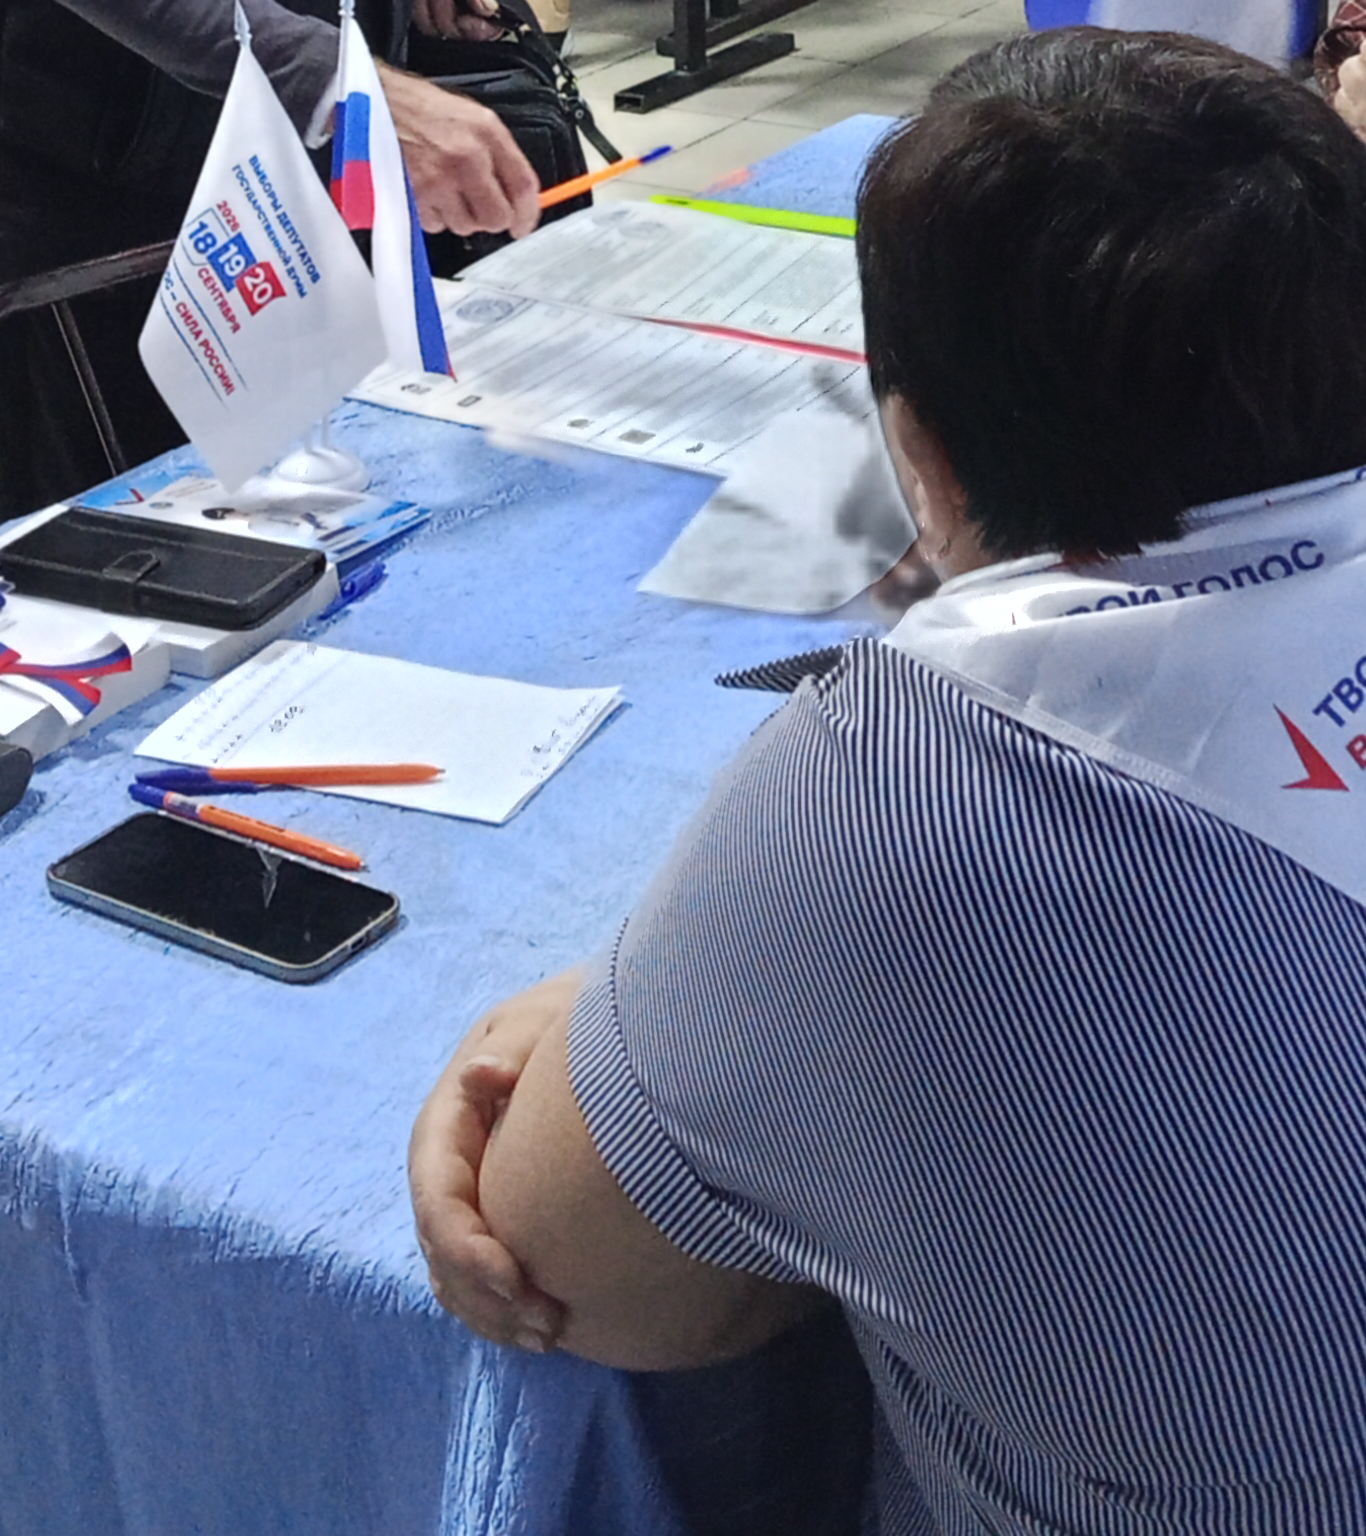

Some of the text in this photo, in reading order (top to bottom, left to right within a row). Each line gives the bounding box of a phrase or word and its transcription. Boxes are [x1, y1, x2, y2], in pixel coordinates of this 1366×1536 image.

[188, 220, 217, 255] 18
[216, 200, 241, 233] 2026
[232, 164, 308, 299] ГОСУДАРСТВЕННОЙ ДУМЫ
[248, 154, 321, 285] ВЫБОРЫ ДЕПУТАТОВ
[218, 241, 246, 277] 19
[197, 267, 241, 334] СЕНТЯБРЯ
[243, 267, 274, 305] 20
[175, 301, 203, 342] СИЛА
[198, 338, 236, 396] РОССИИ!
